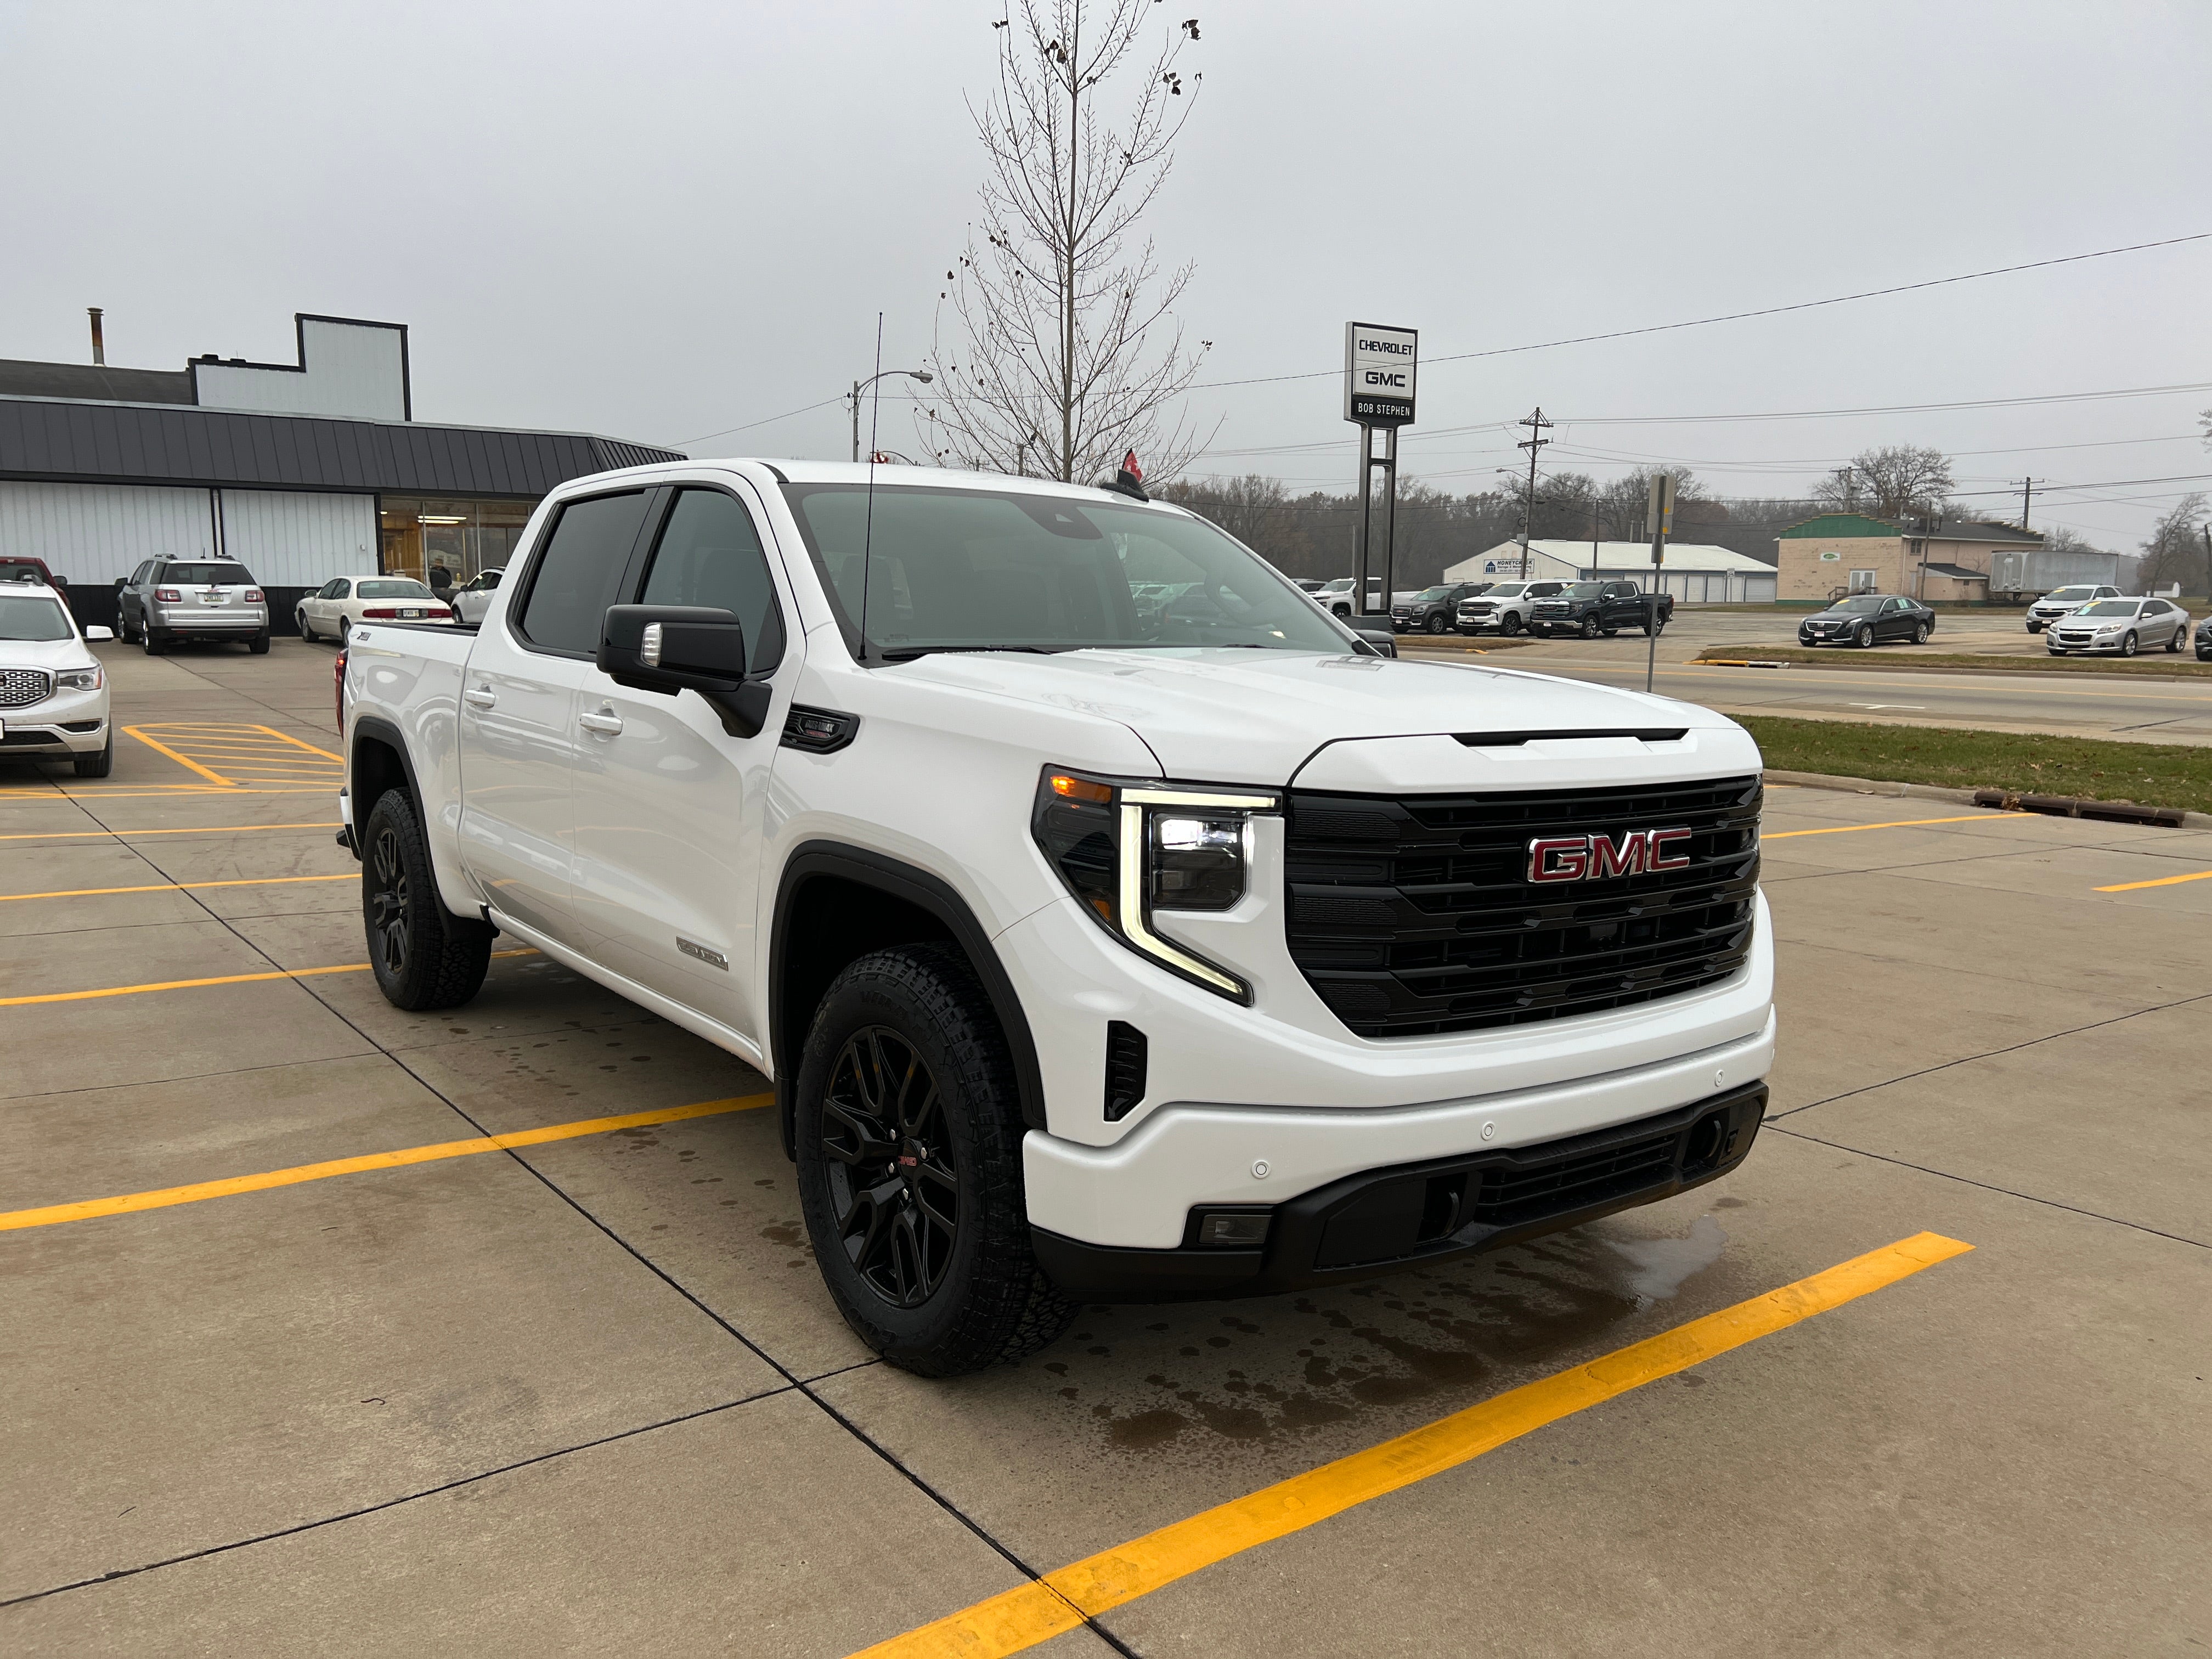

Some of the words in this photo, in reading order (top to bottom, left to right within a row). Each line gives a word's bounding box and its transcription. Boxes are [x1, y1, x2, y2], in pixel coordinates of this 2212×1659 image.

[1359, 339, 1413, 356] CHEVROLET
[1365, 371, 1406, 387] GMC
[1358, 402, 1373, 413] BOB
[1376, 404, 1410, 416] STEPHEN
[1527, 827, 1692, 883] GMC
